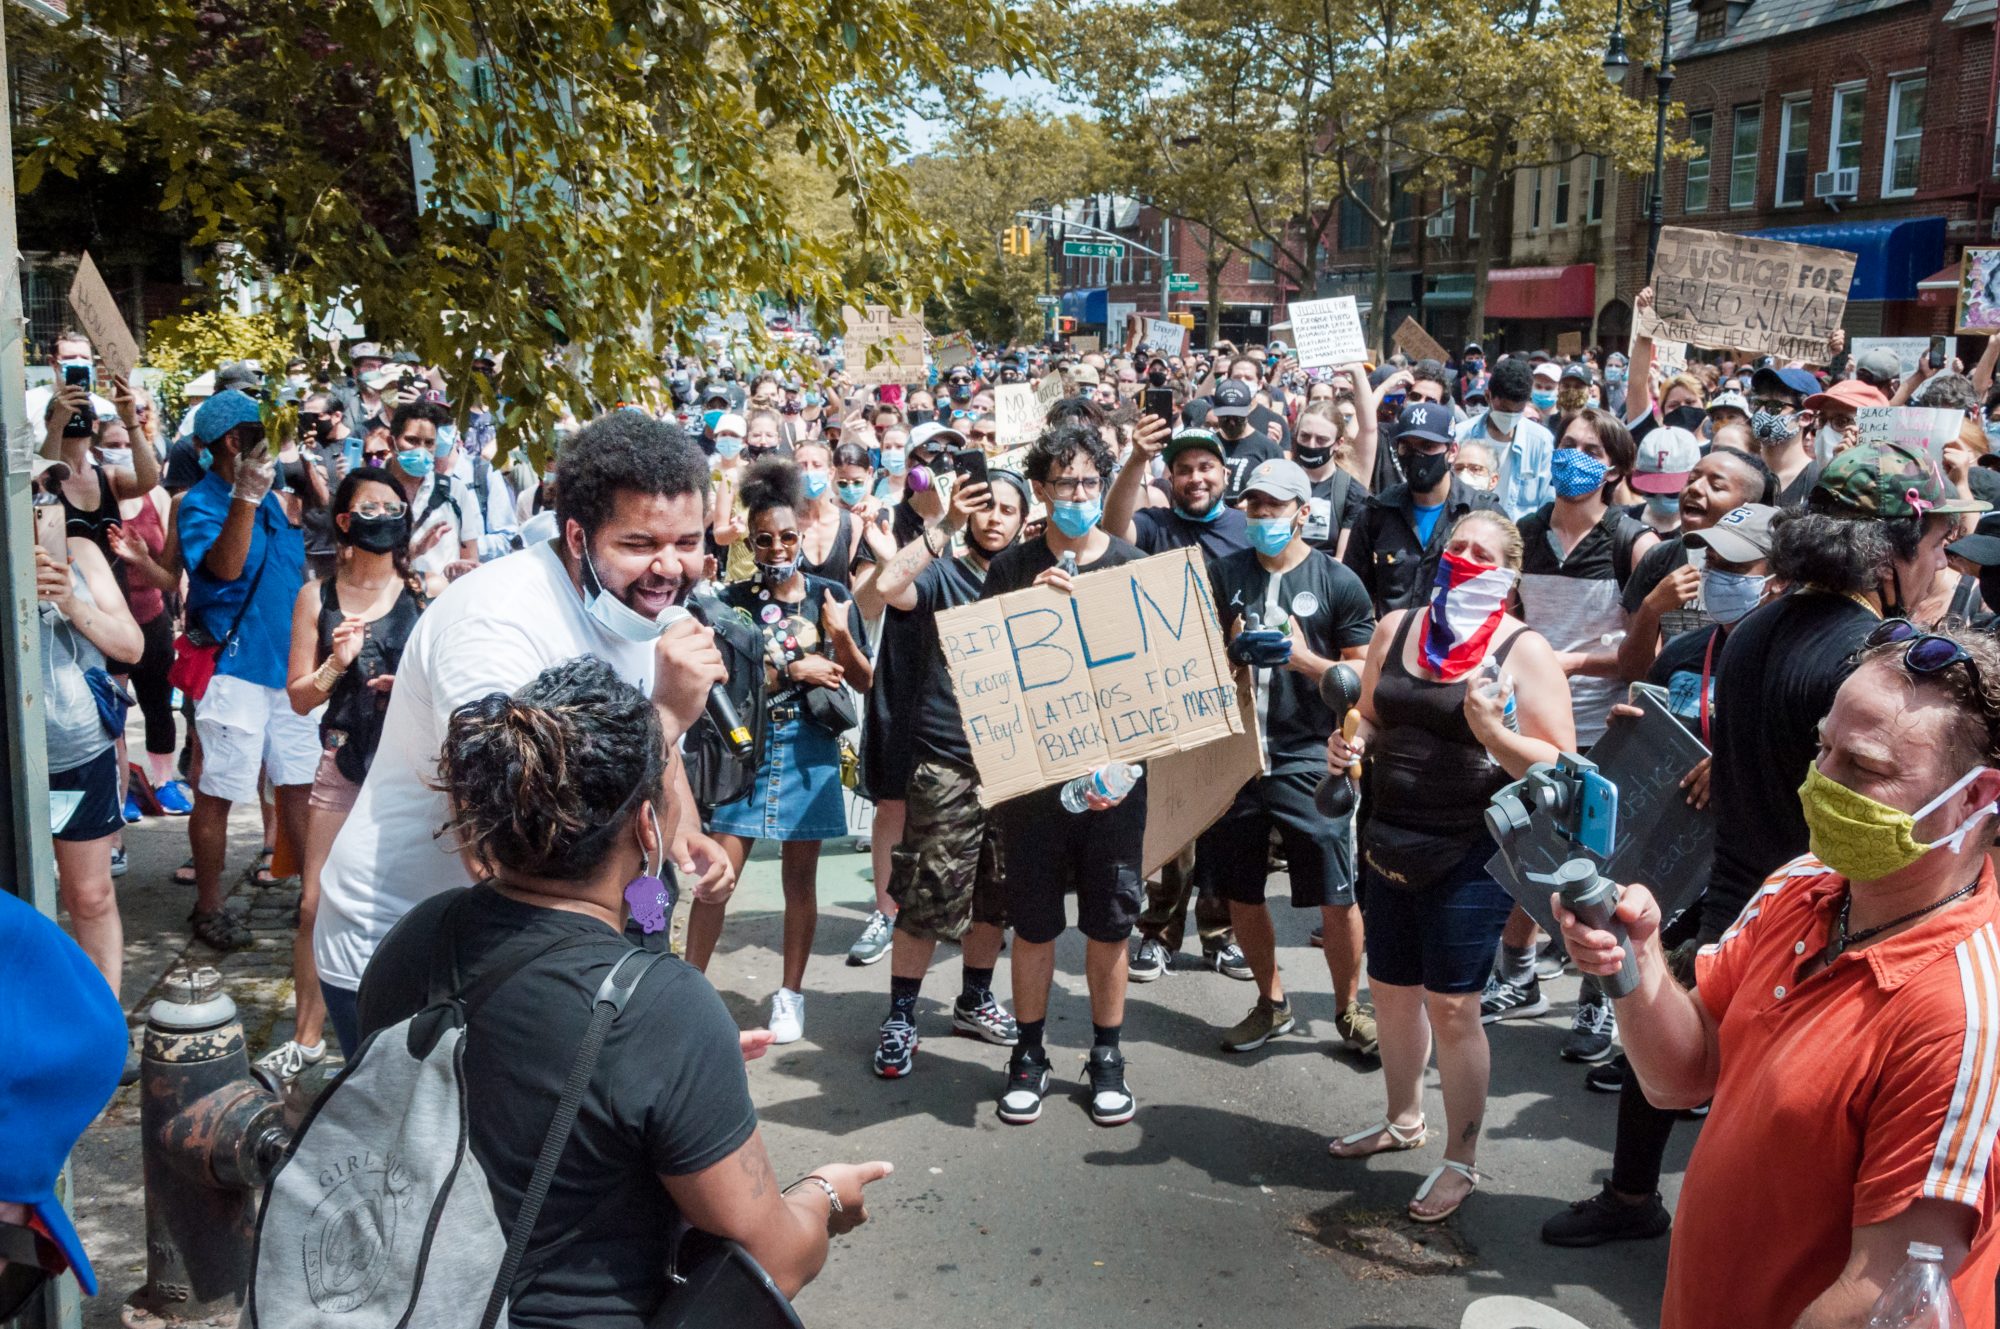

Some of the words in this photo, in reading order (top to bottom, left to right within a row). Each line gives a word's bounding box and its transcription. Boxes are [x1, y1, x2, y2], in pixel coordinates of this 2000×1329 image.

[1080, 245, 1092, 254] 46
[1097, 245, 1109, 254] St
[1658, 231, 1790, 289] Justice
[1798, 265, 1843, 293] FOR
[1153, 320, 1180, 337] Enough
[1652, 321, 1718, 341] ARREST
[1724, 326, 1750, 347] HER
[426, 389, 440, 401] T
[1005, 393, 1025, 411] NO
[1008, 410, 1028, 424] NO
[1410, 407, 1427, 425] NY
[1861, 408, 1893, 419] BLACK
[1859, 423, 1889, 434] BLACK
[1657, 451, 1669, 470] F
[1723, 508, 1753, 526] S
[1005, 560, 1221, 692] BLM
[944, 624, 1001, 663] RIP
[1030, 682, 1132, 730] LATINOS
[1145, 658, 1200, 694] FOR
[969, 704, 1023, 761] Floyd
[1038, 722, 1108, 762] BLACK
[1111, 700, 1180, 743] LIVES
[319, 1151, 374, 1188] GIRL
